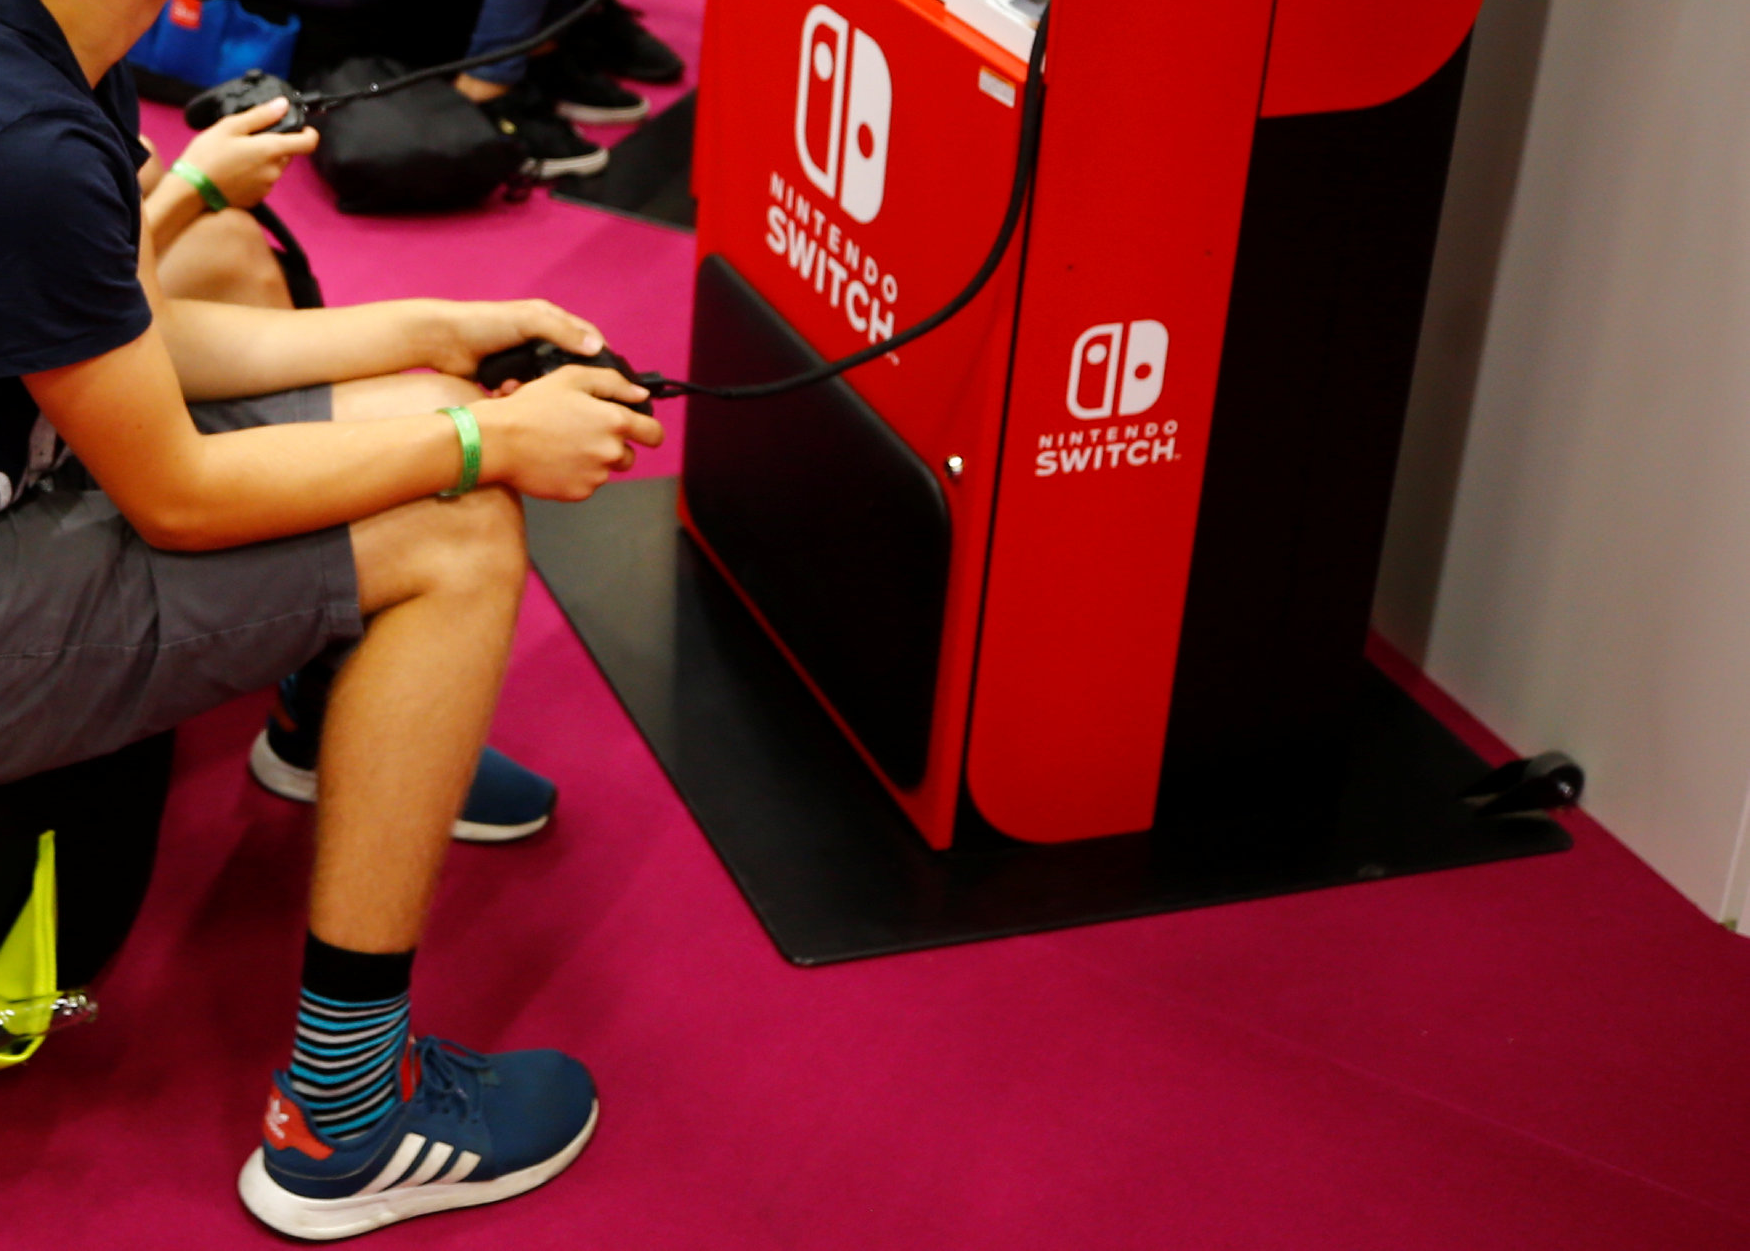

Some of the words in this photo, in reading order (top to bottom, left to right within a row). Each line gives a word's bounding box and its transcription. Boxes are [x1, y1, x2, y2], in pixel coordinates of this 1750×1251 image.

[766, 205, 895, 345] SWITCH
[769, 171, 898, 304] NINTENDO
[1035, 436, 1176, 477] SWITCH
[1038, 419, 1179, 449] NINTENDO
